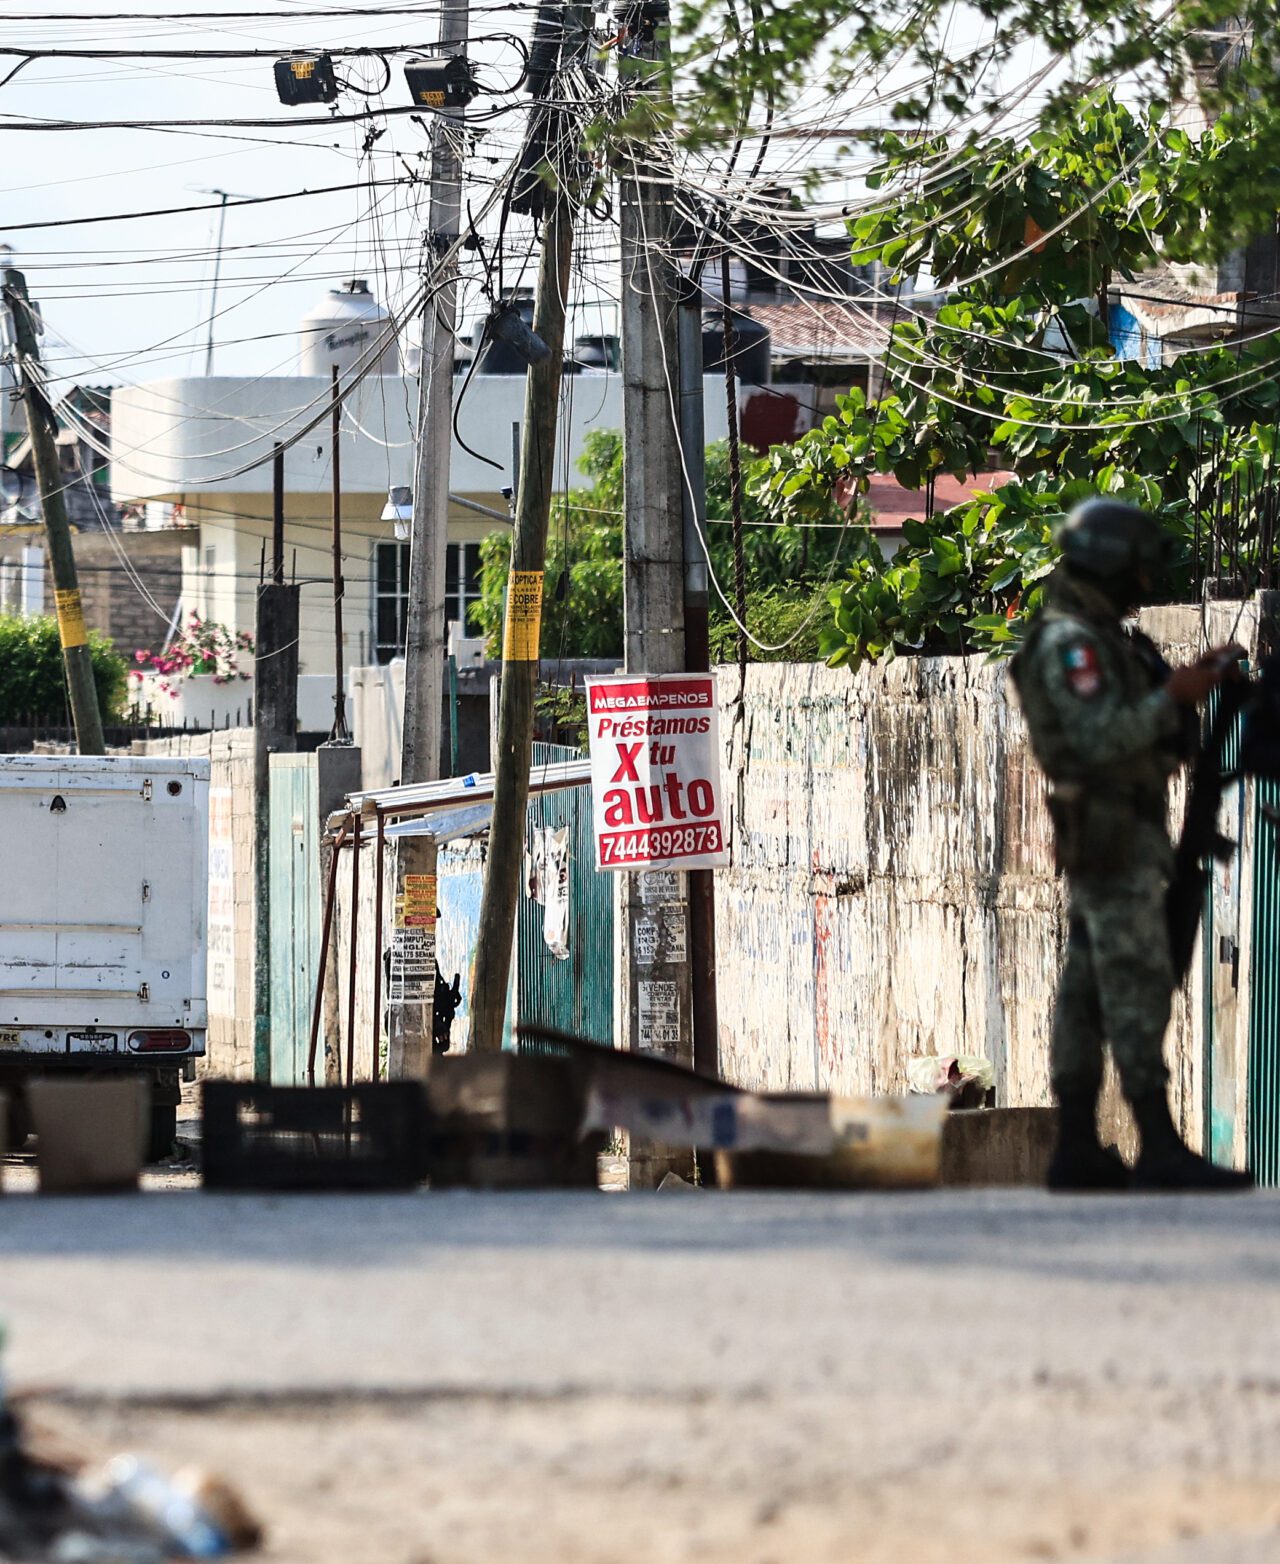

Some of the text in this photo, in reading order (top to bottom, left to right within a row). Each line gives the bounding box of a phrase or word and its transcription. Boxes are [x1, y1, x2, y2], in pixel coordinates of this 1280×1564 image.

[514, 594, 539, 604] COBRE
[595, 691, 709, 710] MEGAEMPEÑOS
[598, 715, 711, 739] Préstamos
[649, 741, 676, 766] tu
[603, 773, 715, 828] auto
[602, 826, 719, 862] 7444392873
